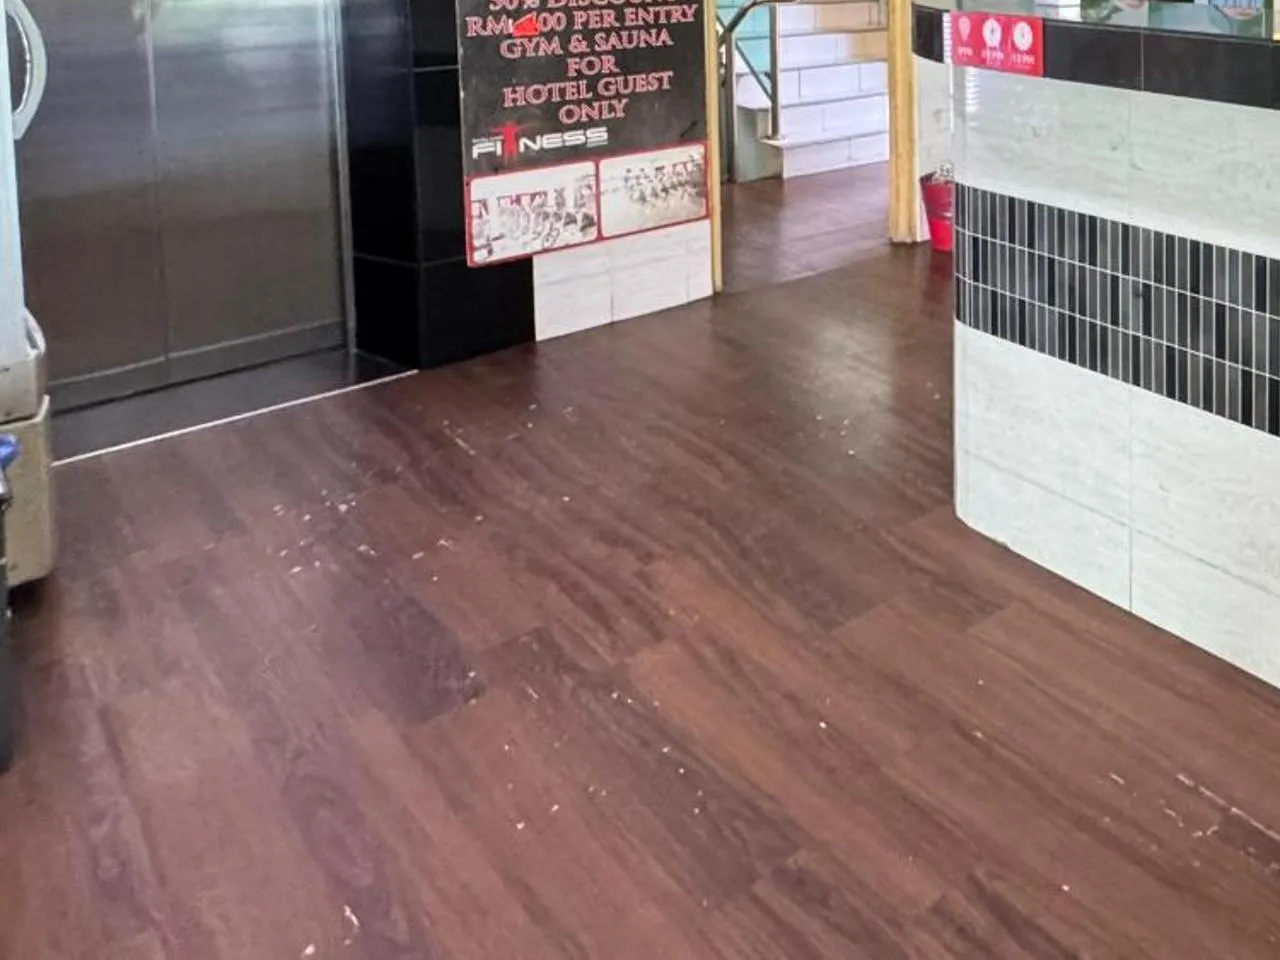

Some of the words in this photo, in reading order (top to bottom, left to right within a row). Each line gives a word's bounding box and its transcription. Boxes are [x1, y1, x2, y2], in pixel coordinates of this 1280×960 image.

[573, 9, 620, 30] PER
[624, 3, 699, 26] ENTRY
[500, 37, 564, 59] GYM
[568, 33, 590, 53] &
[594, 27, 674, 53] SAUNA
[567, 54, 620, 77] FOR
[503, 81, 593, 108] HOTEL
[596, 71, 674, 96] GUEST
[558, 98, 630, 125] ONLY
